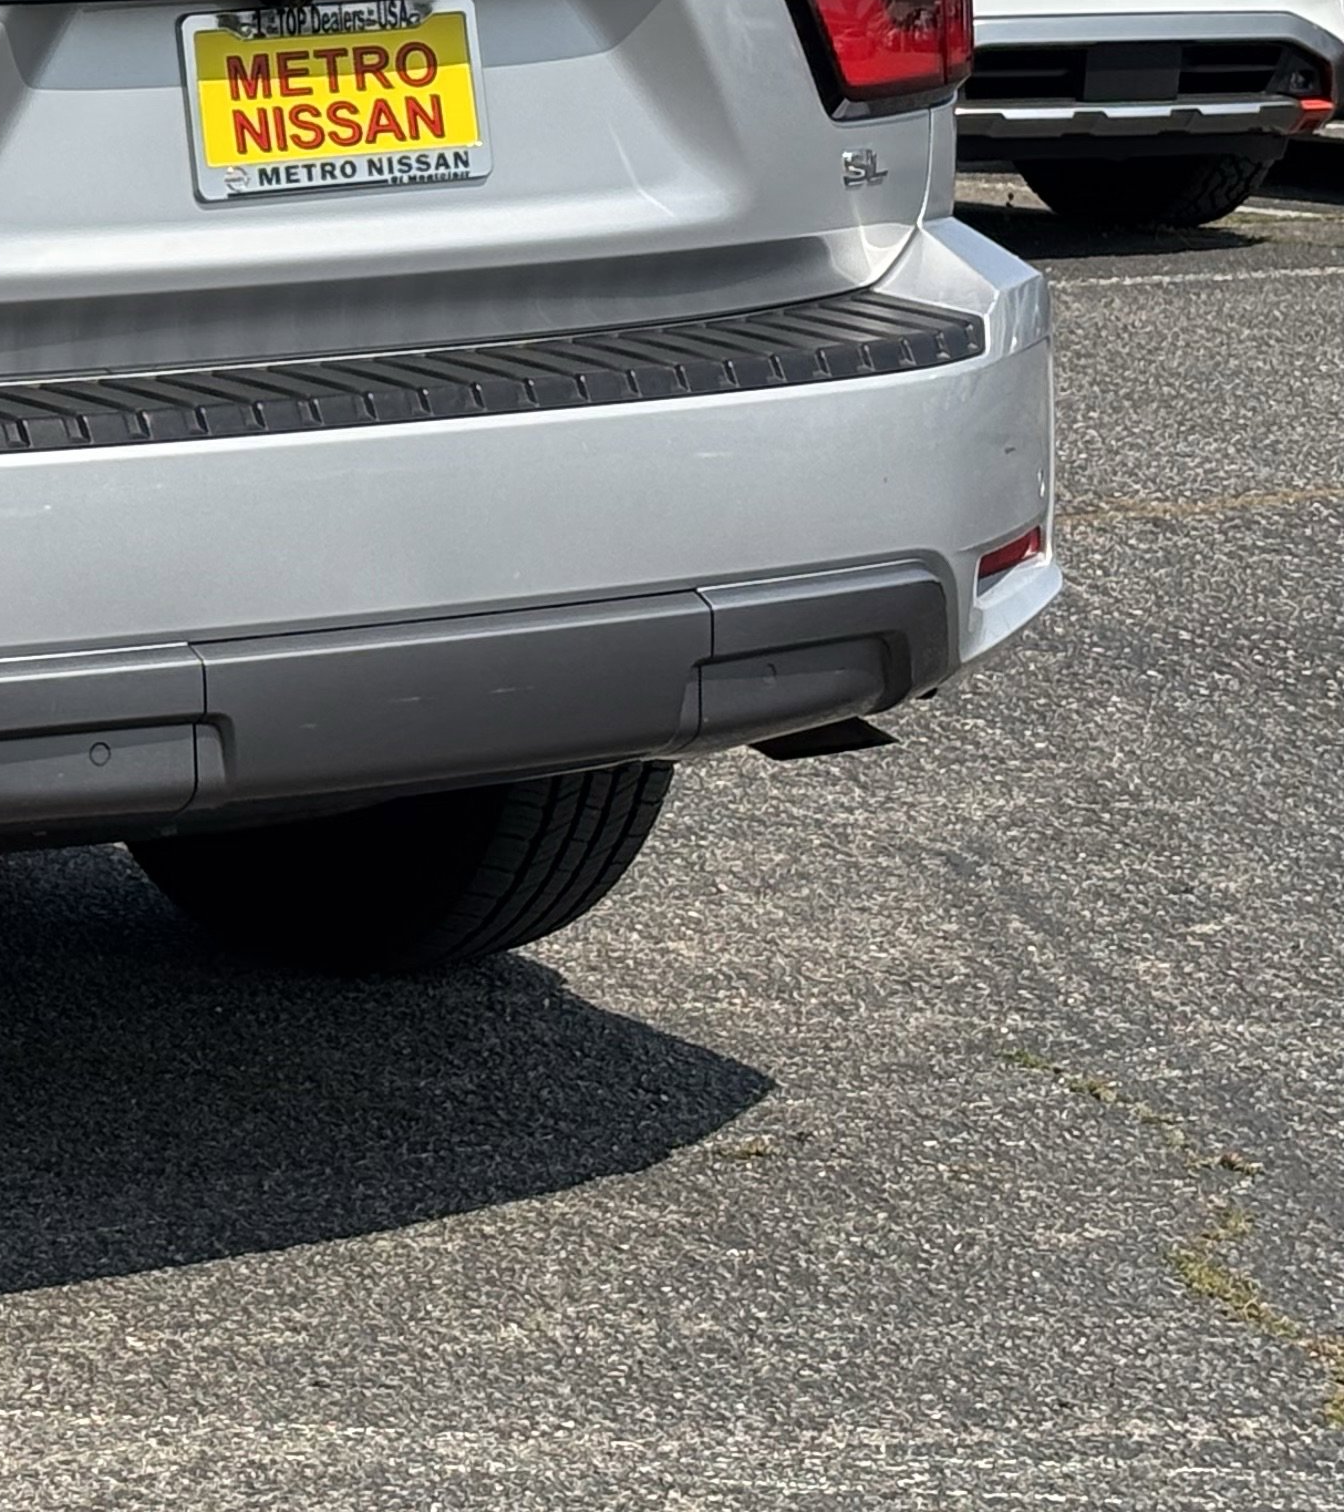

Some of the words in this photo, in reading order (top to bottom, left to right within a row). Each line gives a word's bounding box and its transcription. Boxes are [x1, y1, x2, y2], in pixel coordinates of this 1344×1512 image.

[277, 7, 307, 37] TOP
[311, 3, 365, 33] Dealers
[376, 0, 409, 29] USA
[225, 41, 438, 101] METRO
[232, 94, 446, 155] NISSAN
[258, 160, 358, 187] METRO
[367, 151, 471, 177] NISSAN
[842, 149, 889, 189] SL
